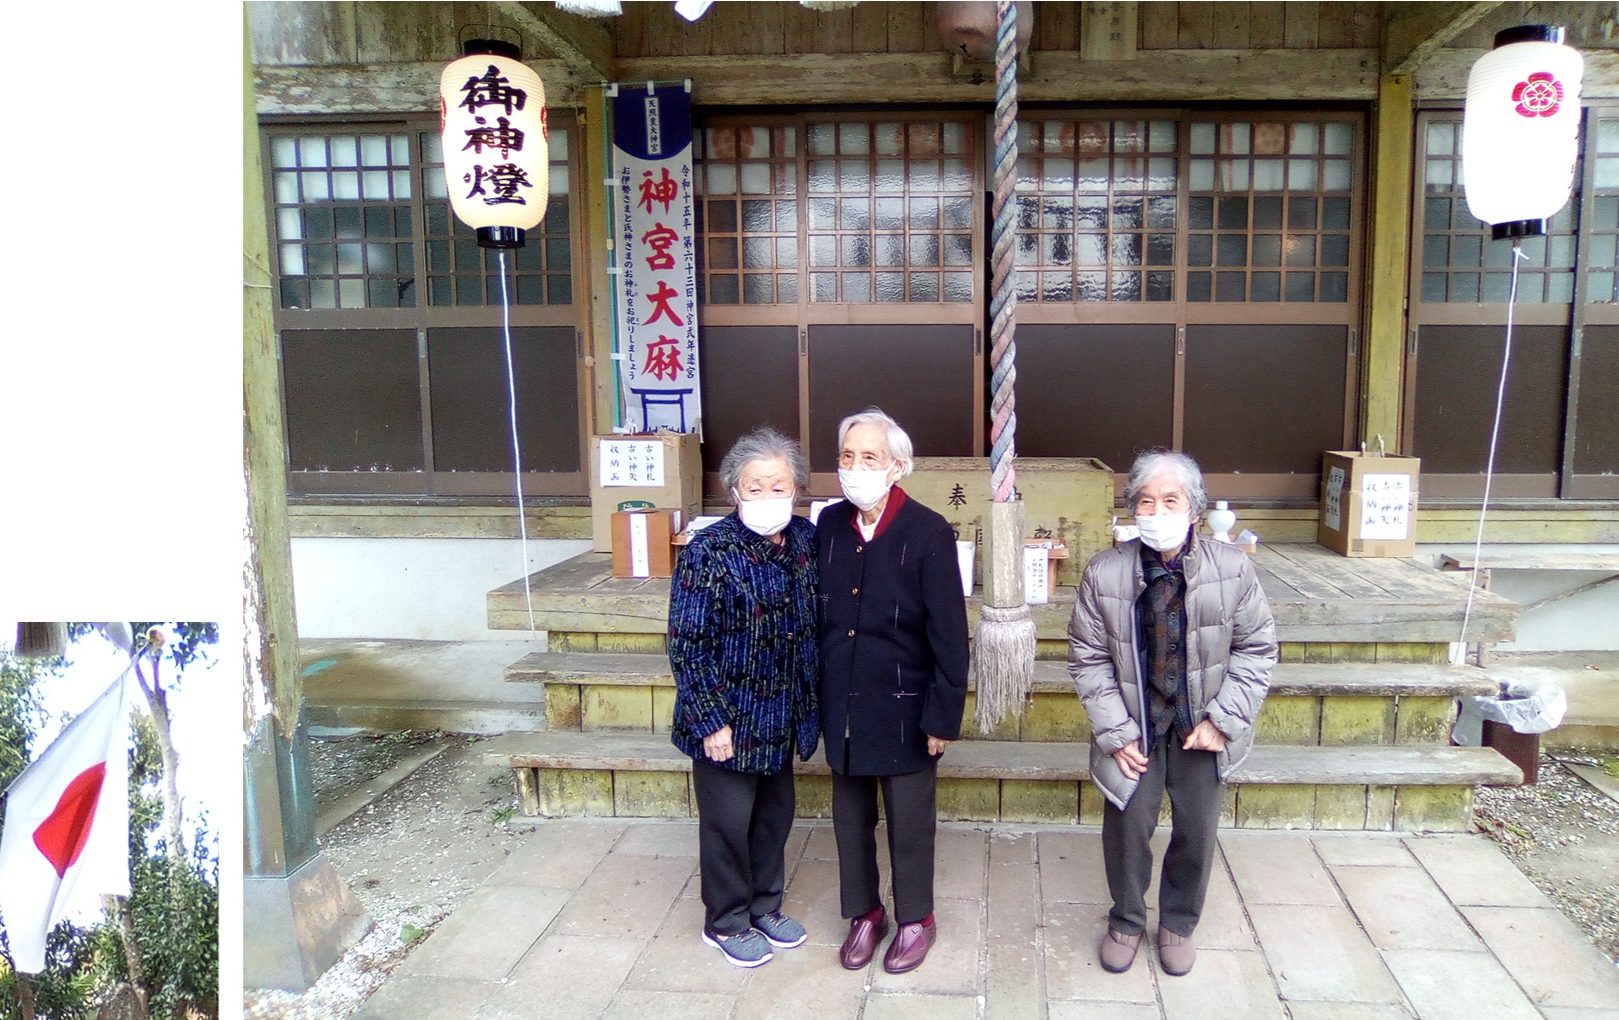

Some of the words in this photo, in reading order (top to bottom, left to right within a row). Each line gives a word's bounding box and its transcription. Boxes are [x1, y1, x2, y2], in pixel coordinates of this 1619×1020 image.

[458, 64, 534, 206] 御神燈
[636, 166, 685, 382] 神宮大麻
